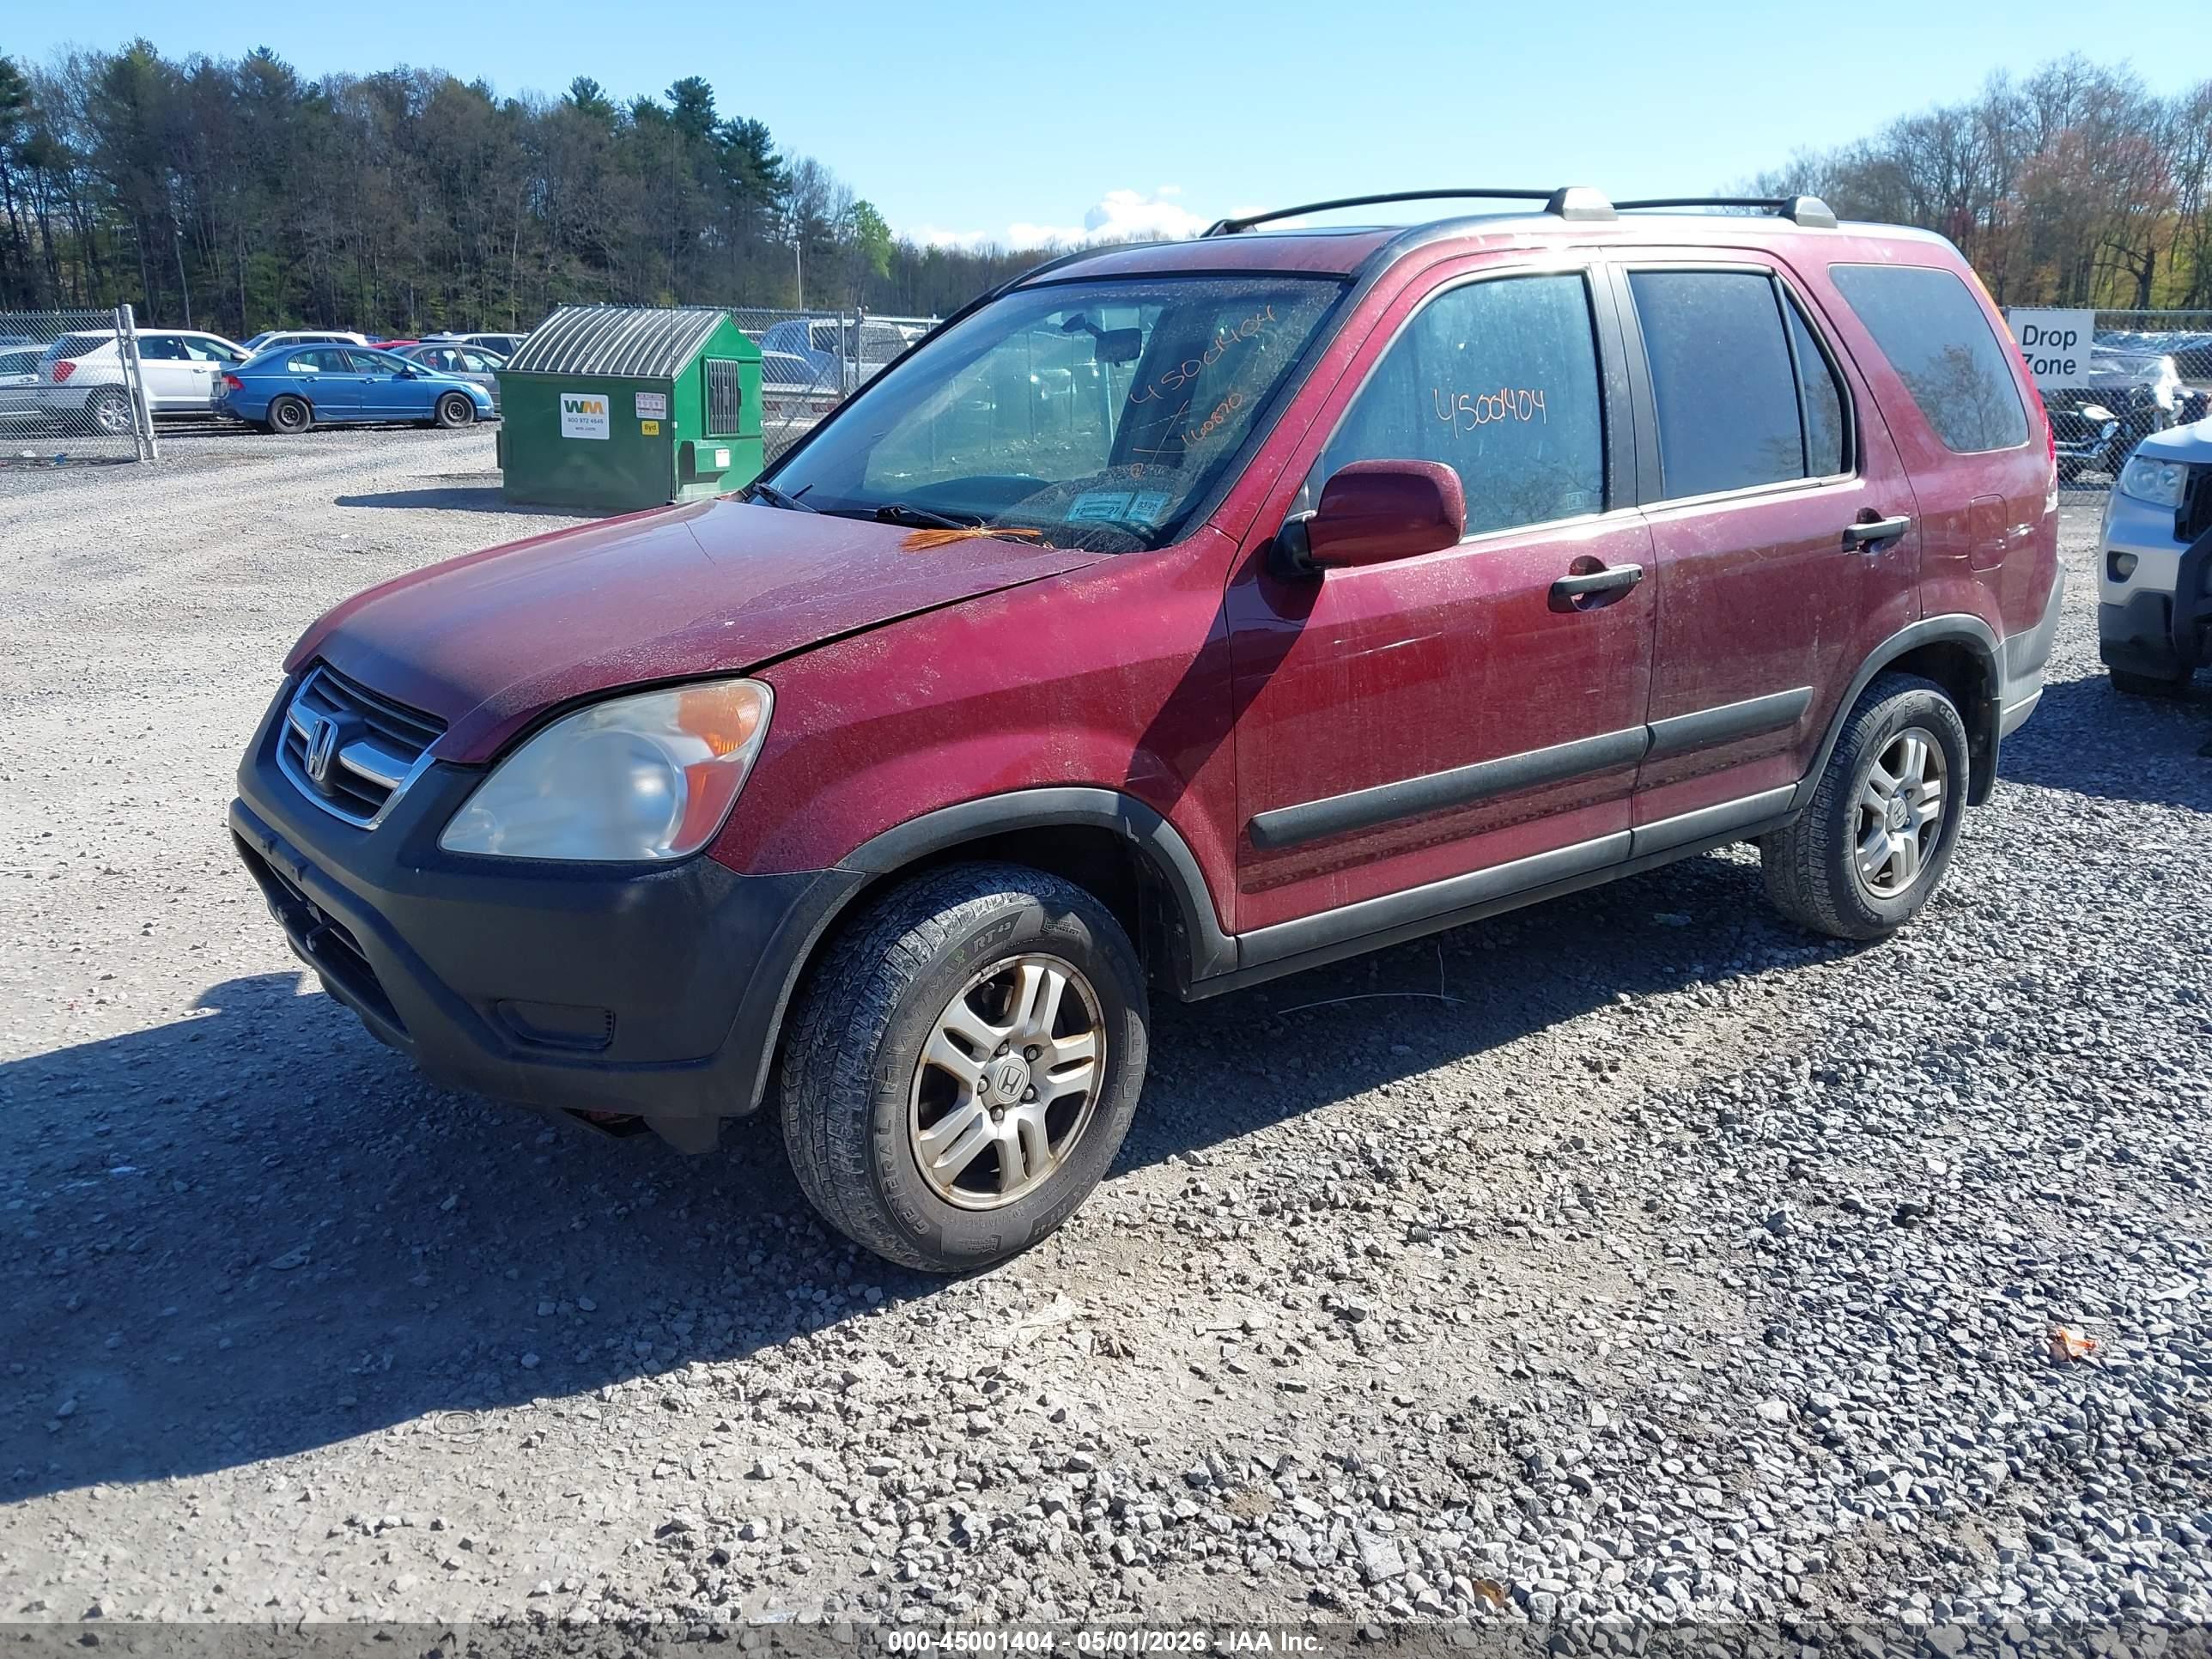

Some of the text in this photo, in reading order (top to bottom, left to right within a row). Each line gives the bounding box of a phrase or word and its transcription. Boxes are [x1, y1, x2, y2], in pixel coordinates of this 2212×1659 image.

[2022, 325, 2077, 350] Drop
[563, 399, 605, 415] WM
[972, 928, 997, 954] RT
[878, 1119, 931, 1235] GENERAL
